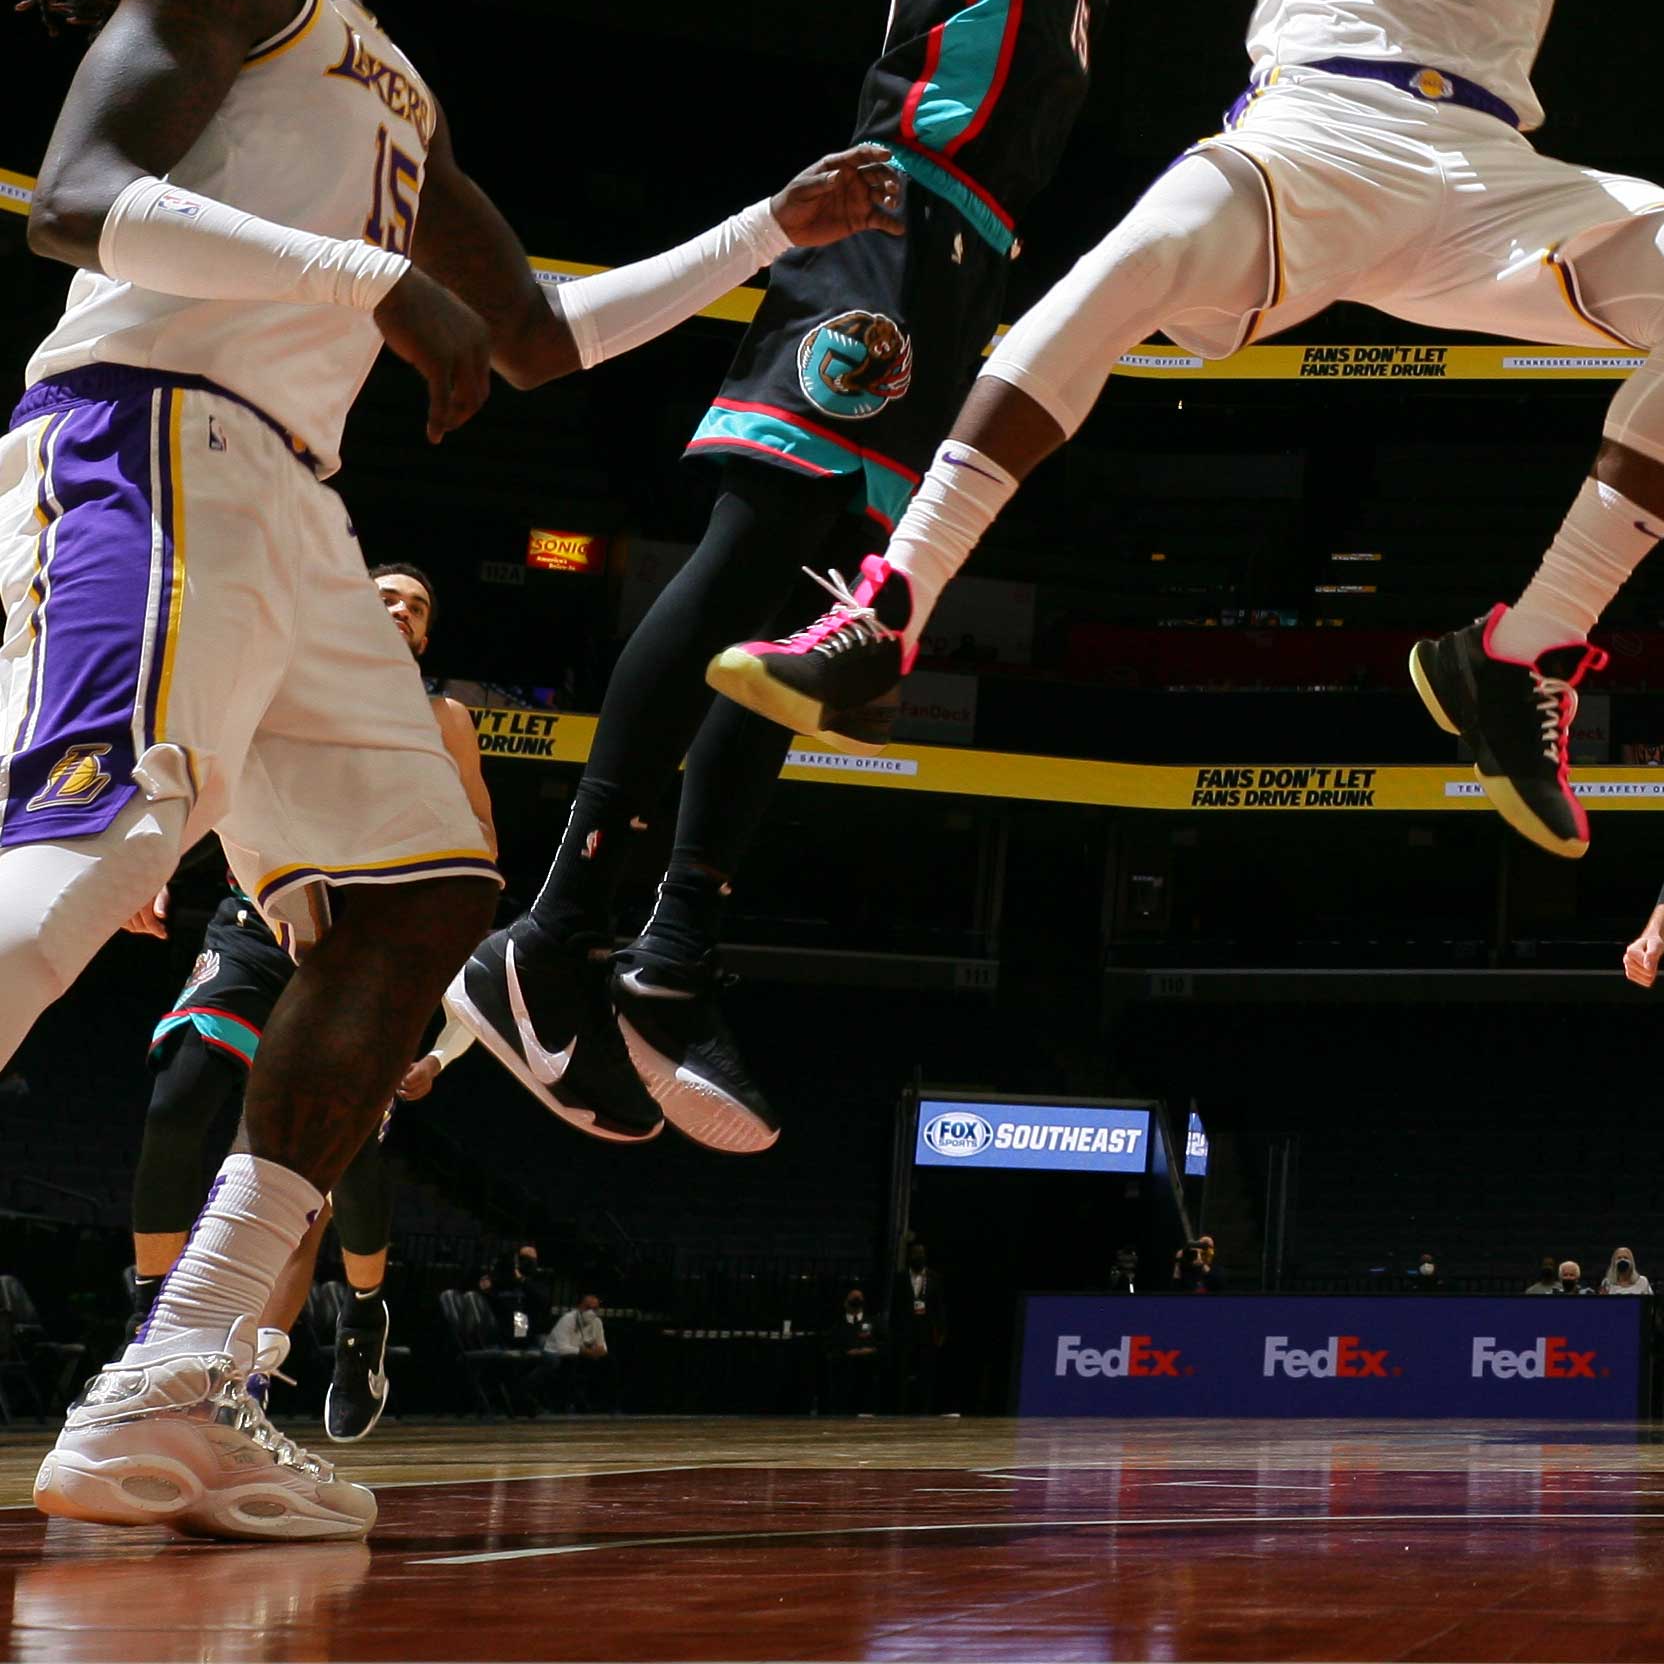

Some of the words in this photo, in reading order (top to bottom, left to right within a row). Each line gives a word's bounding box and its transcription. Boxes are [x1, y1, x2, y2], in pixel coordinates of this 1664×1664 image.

[363, 120, 421, 261] 15
[1155, 358, 1191, 366] OFFICE
[1304, 348, 1350, 362] FANS
[1353, 346, 1411, 362] DON'T
[1413, 348, 1448, 362] LET
[1301, 364, 1339, 377] FANS
[1341, 364, 1388, 377] DRIVE
[1391, 364, 1447, 377] DRUNK
[536, 539, 586, 554] SONIC
[511, 714, 558, 736] LET
[478, 733, 555, 756] DRUNK
[800, 754, 849, 765] SAFETY
[857, 759, 902, 770] OFFICE
[1195, 770, 1255, 788] FANS
[1258, 768, 1331, 788] DON'T
[1334, 770, 1376, 788] LET
[1192, 790, 1241, 806] FANS
[1244, 790, 1301, 806] DRIVE
[1304, 790, 1374, 806] DRUNK
[1600, 785, 1646, 793] SAFETY
[940, 1121, 978, 1139] FOX
[994, 1123, 1142, 1154] SOUTHEAST
[938, 1138, 978, 1148] SPORTS
[1055, 1335, 1182, 1378] FedEx
[1263, 1336, 1389, 1379] FedEx
[1471, 1336, 1597, 1379] FedEx
